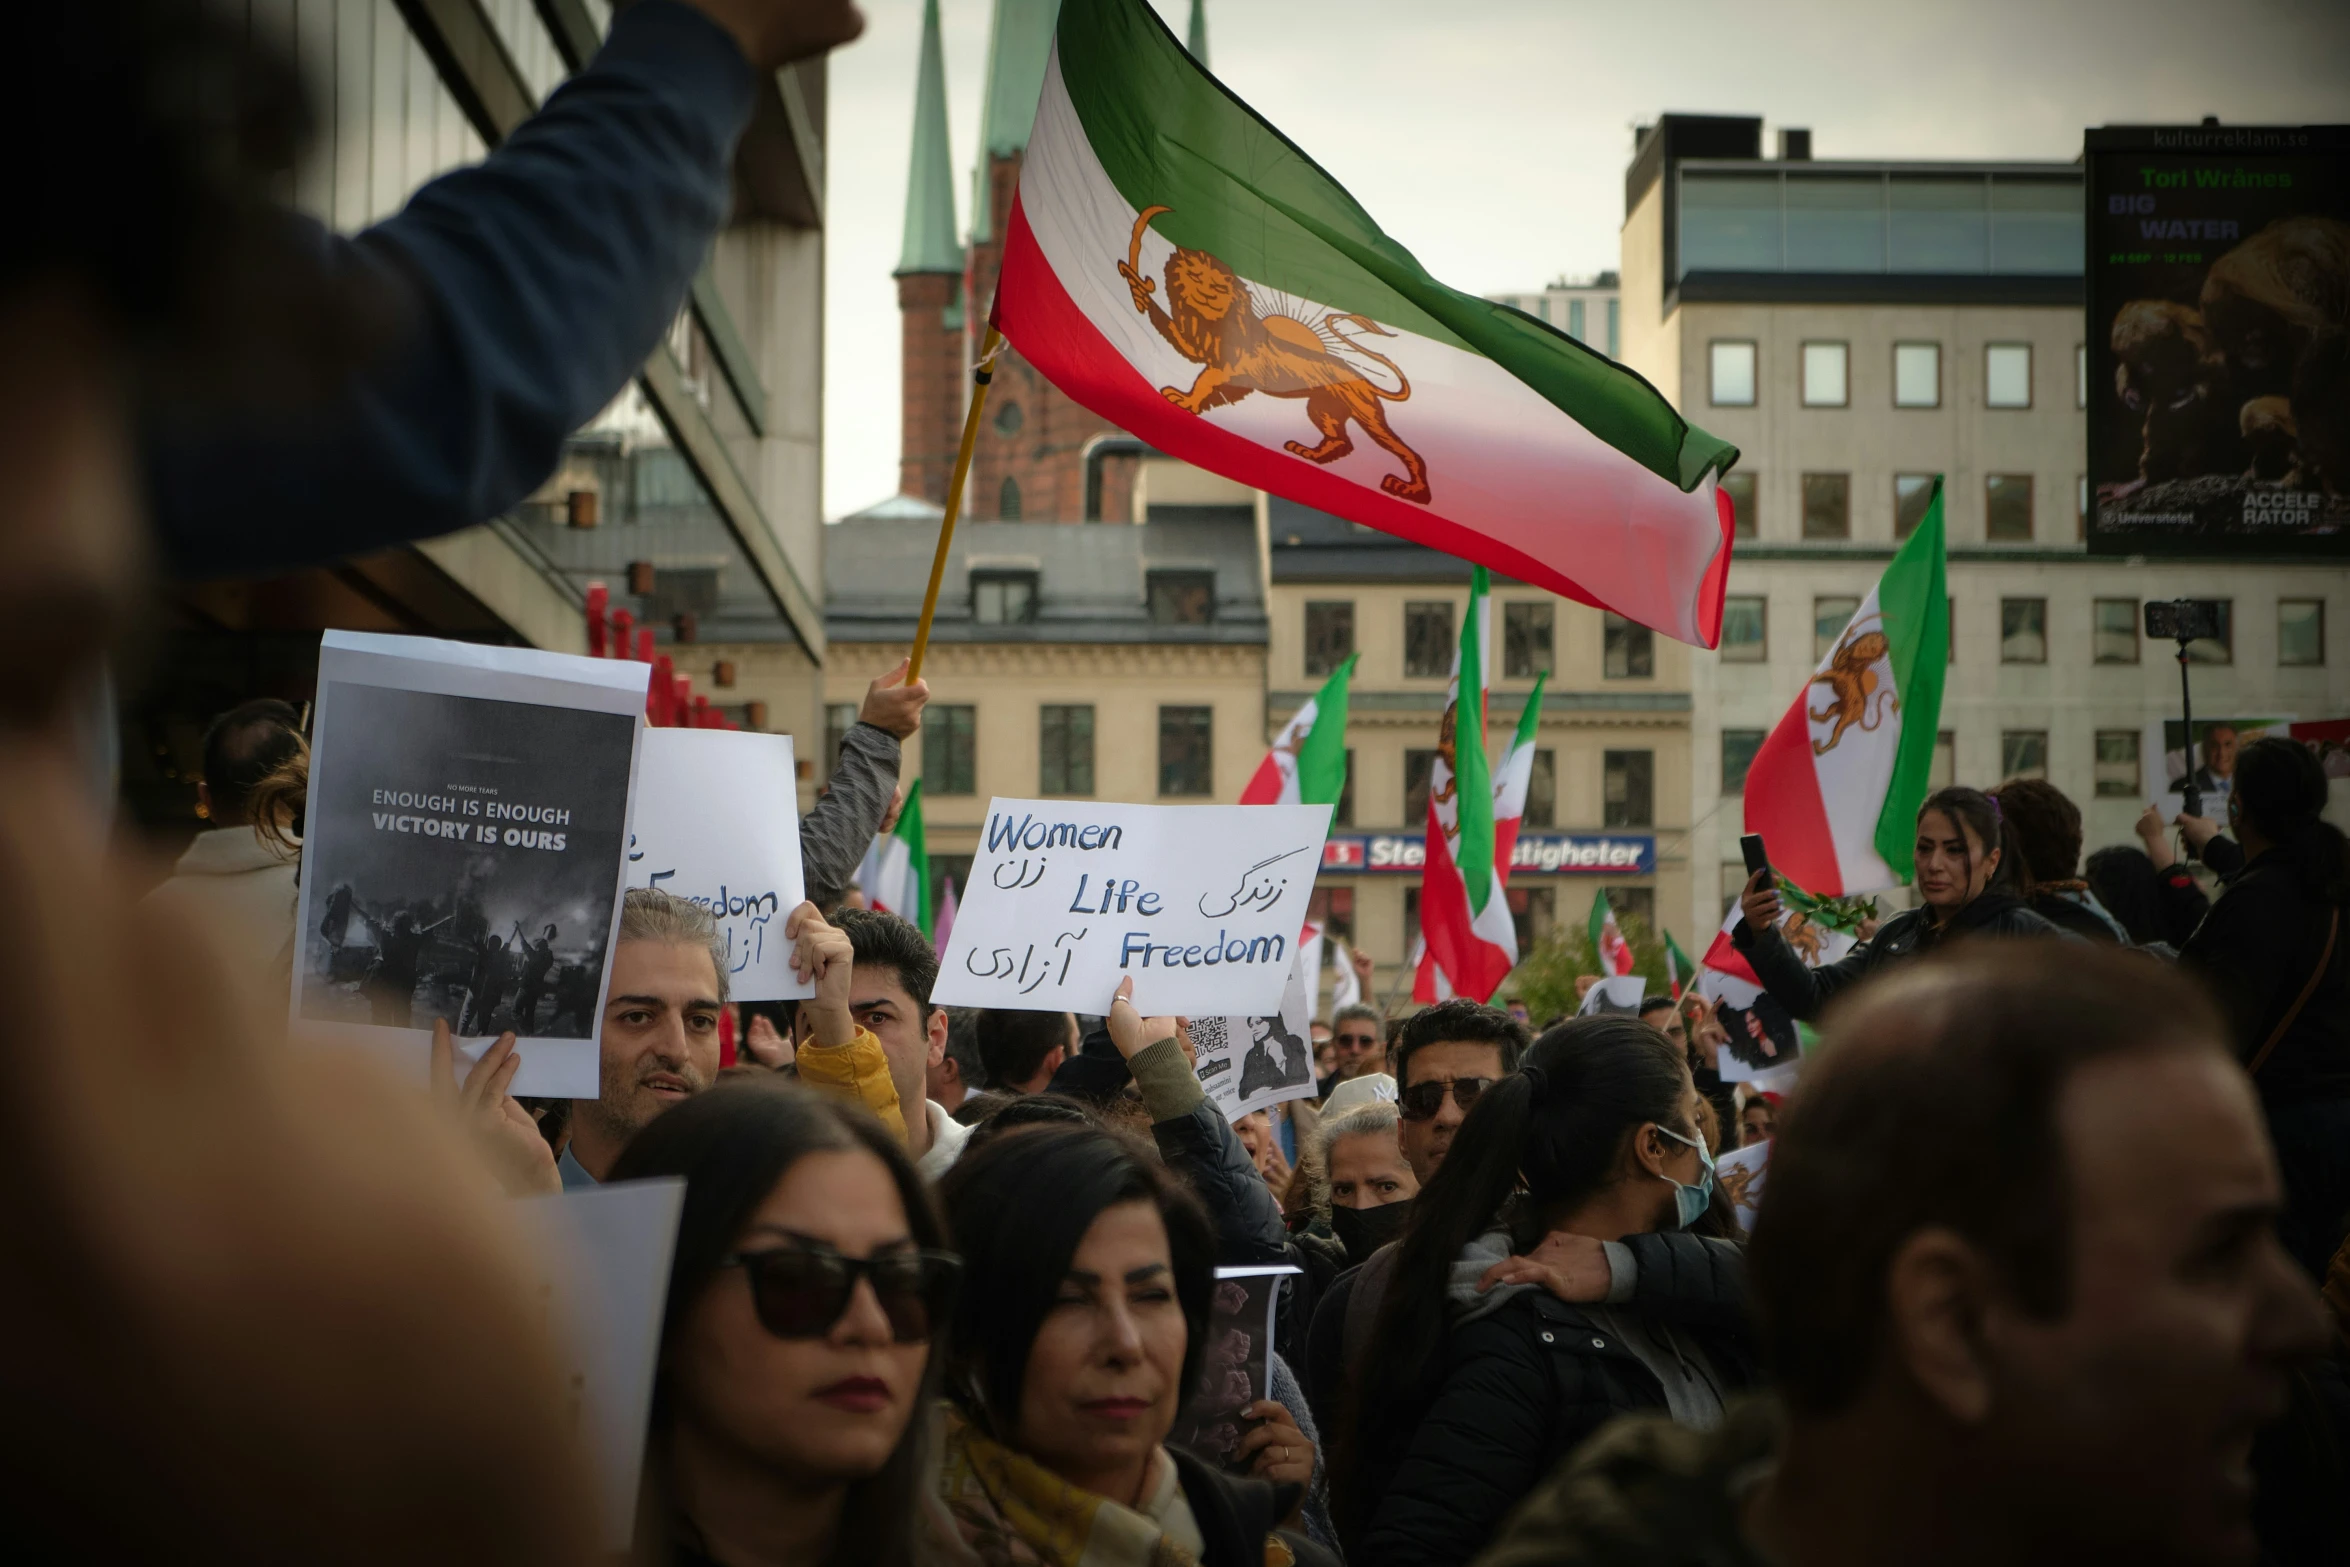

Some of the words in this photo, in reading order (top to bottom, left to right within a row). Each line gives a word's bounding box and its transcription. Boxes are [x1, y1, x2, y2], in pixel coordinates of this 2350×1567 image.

[2153, 129, 2309, 148] kulturreklam.se
[2140, 168, 2187, 188] Tori
[2194, 167, 2292, 188] Wrånes
[2108, 194, 2157, 215] BIG
[2140, 219, 2240, 240] WATER
[2243, 492, 2320, 509] ACCELE
[2243, 509, 2310, 525] RATOR
[447, 784, 458, 792] NO
[458, 785, 477, 793] MORE
[479, 787, 498, 795] TEARS
[372, 789, 455, 814] ENOUGH
[462, 799, 479, 816] IS
[486, 802, 570, 826] ENOUGH
[372, 812, 470, 841] VICTORY
[476, 825, 497, 844] IS
[504, 828, 567, 851] OURS
[988, 813, 1123, 853] Women
[994, 857, 1047, 889] زن
[1069, 873, 1164, 916] Life
[1119, 929, 1285, 969] Freedom
